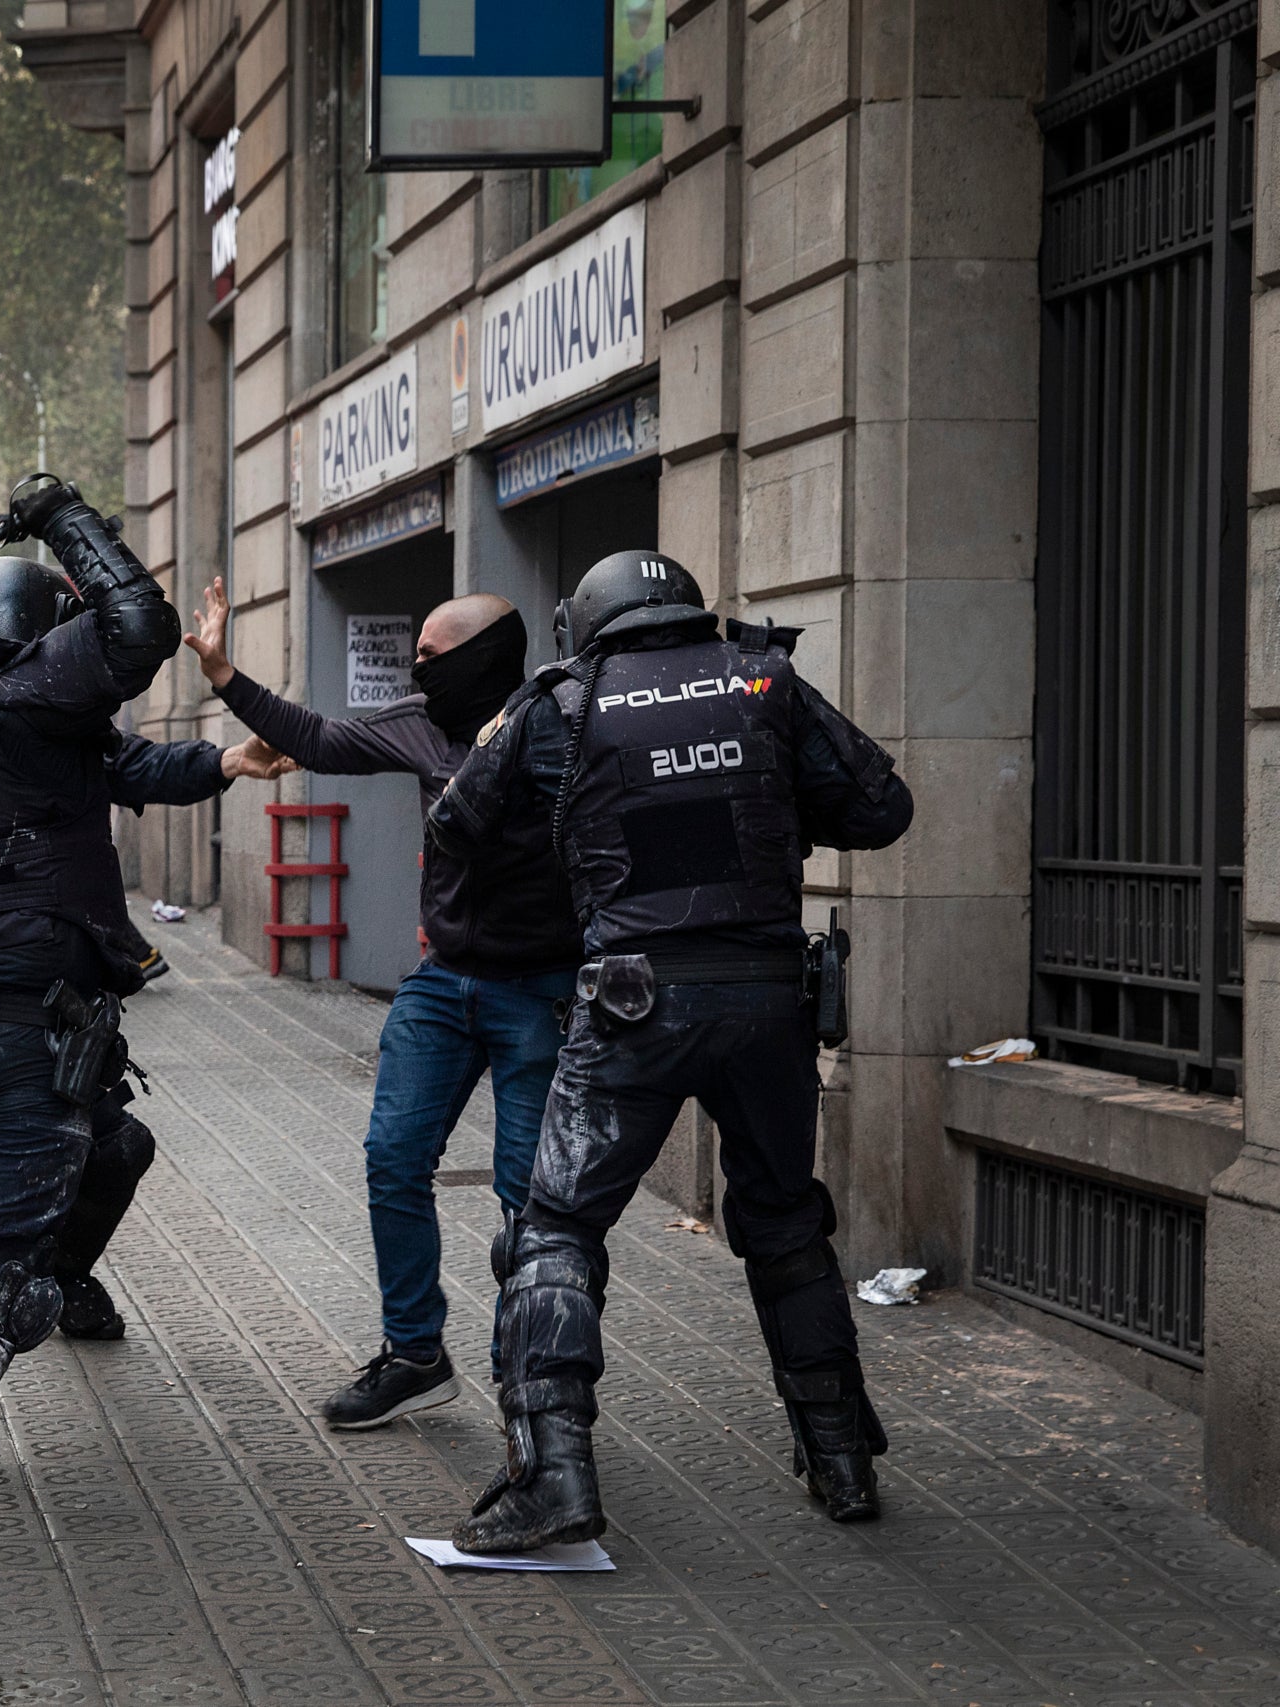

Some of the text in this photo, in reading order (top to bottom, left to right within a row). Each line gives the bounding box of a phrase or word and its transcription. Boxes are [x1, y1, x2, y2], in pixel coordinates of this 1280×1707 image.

[449, 79, 537, 112] LIBRE
[322, 236, 638, 488] PARKING URQUINAONA
[497, 408, 632, 498] URQUINAONA
[597, 675, 750, 713] POLICIA
[650, 740, 743, 778] 2U00
